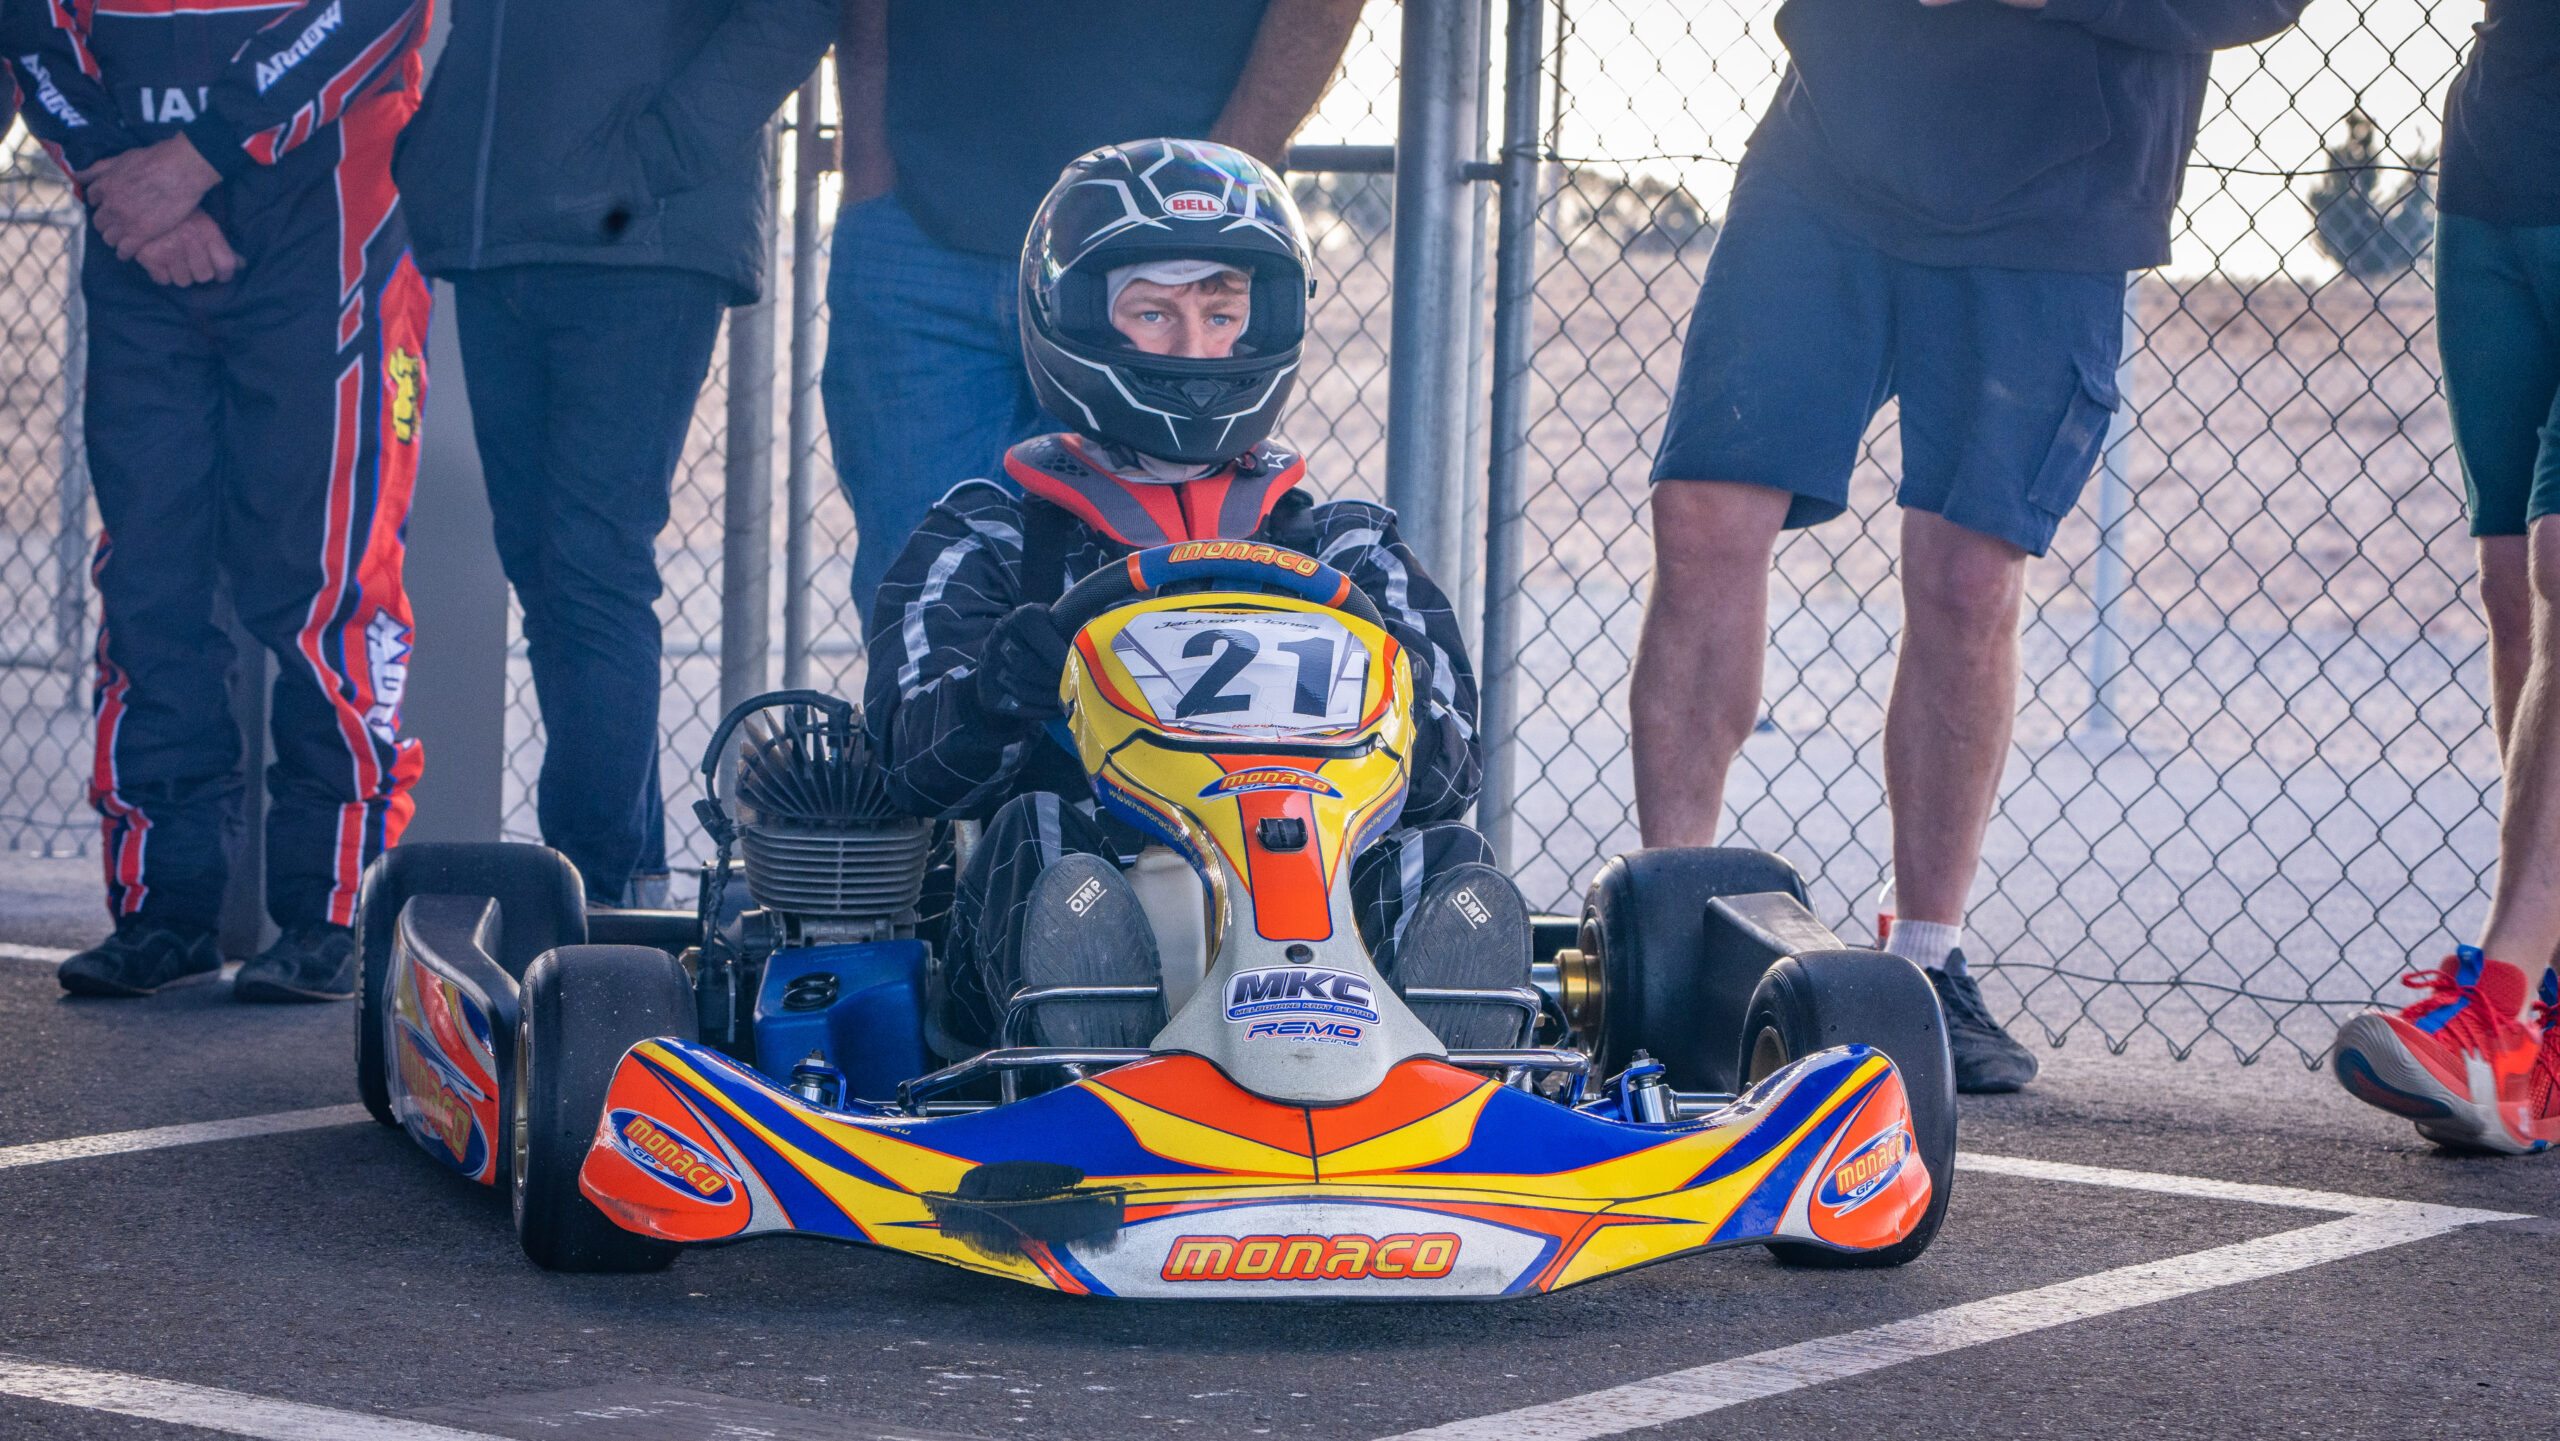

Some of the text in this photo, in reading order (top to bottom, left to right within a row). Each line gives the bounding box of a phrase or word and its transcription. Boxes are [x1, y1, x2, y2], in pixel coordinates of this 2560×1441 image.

[1171, 198, 1218, 212] BELL
[1154, 617, 1320, 630] Jackson Jones
[1175, 628, 1335, 720] 21
[1070, 879, 1101, 912] OMP
[1456, 891, 1488, 924] OMP
[1231, 970, 1371, 1008] MKC
[1234, 1002, 1301, 1016] MELBOURNE
[1334, 1005, 1375, 1019] CENTRE
[1247, 1021, 1362, 1039] REMO
[632, 1146, 656, 1164] GP
[1855, 1179, 1874, 1196] GP
